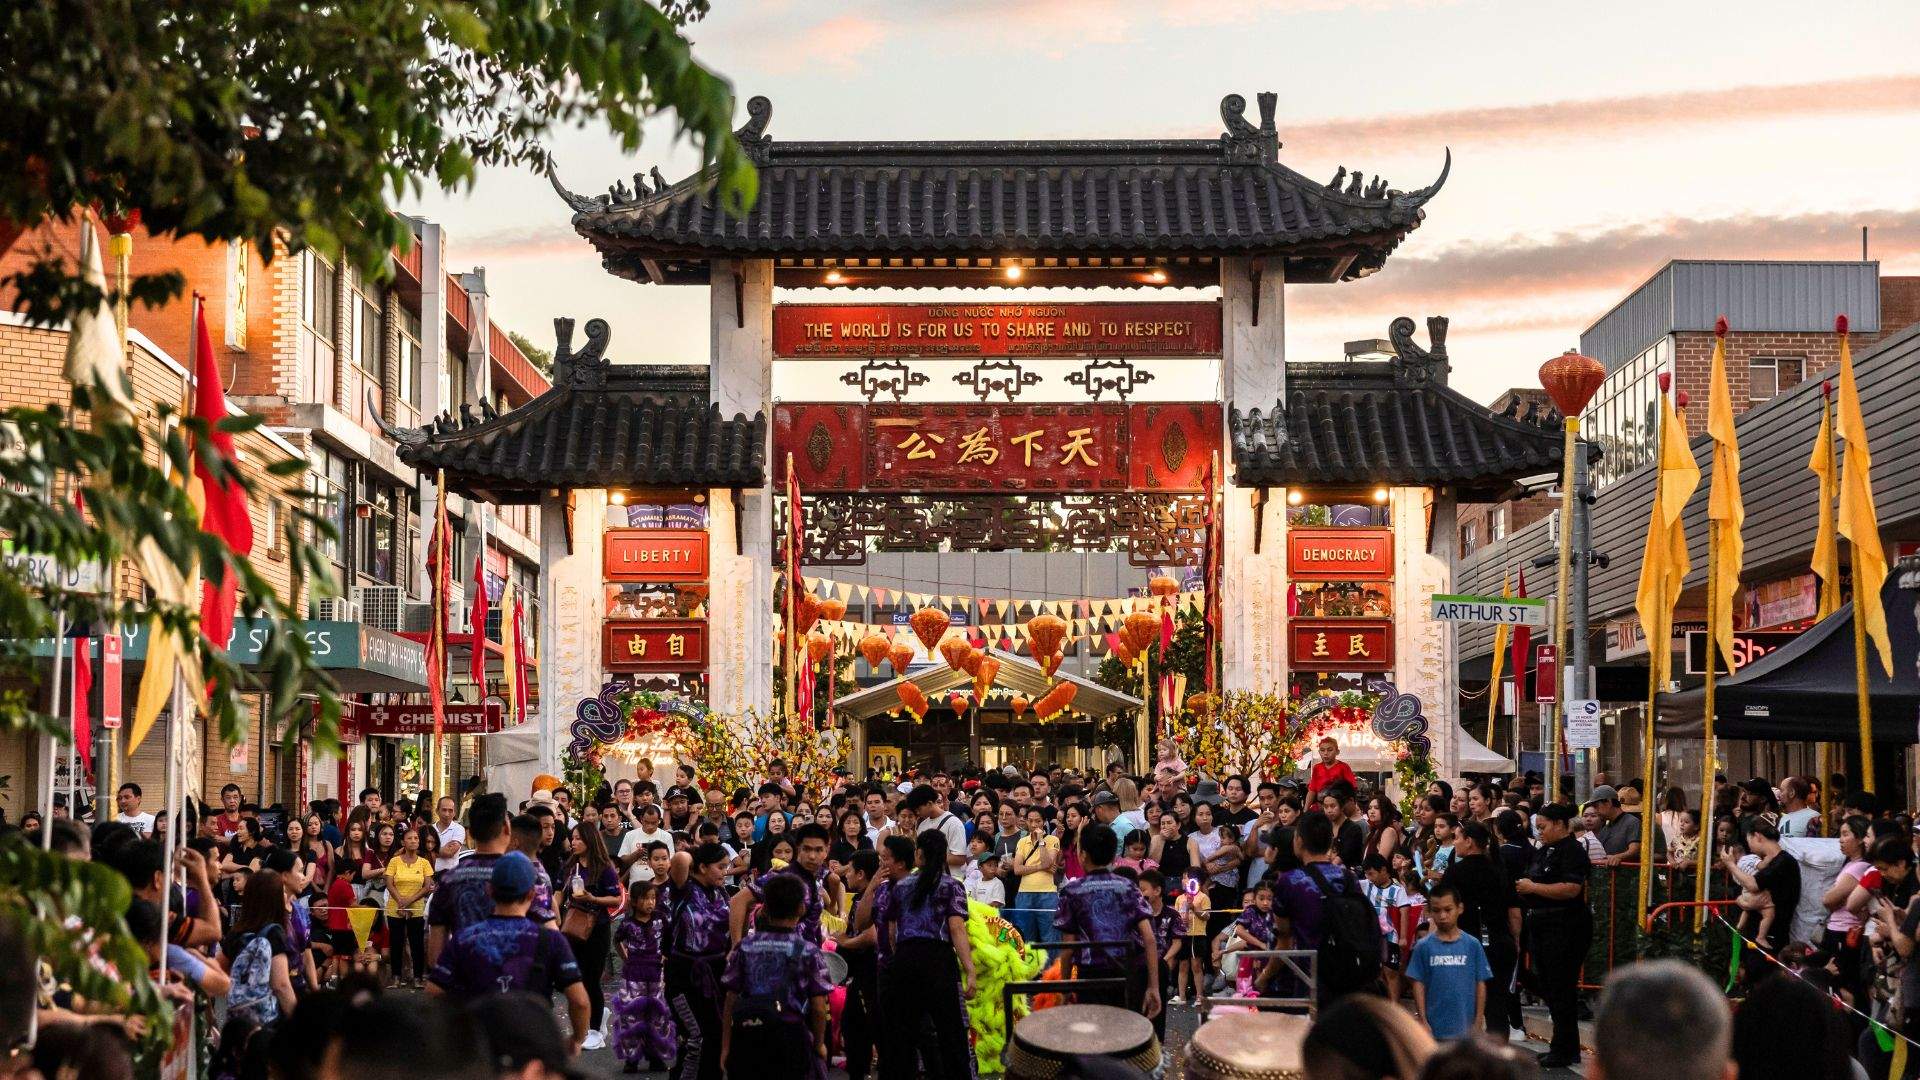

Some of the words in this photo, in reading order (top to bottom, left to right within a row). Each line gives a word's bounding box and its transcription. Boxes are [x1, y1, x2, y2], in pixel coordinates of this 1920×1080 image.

[804, 322, 833, 338] THE
[840, 322, 891, 338] WORLD
[897, 322, 912, 338] IS
[918, 322, 947, 338] FOR
[953, 322, 974, 338] US
[980, 322, 1000, 337] TO
[1006, 321, 1055, 337] SHARE
[1062, 321, 1092, 337] AND
[1099, 321, 1118, 337] TO
[1124, 321, 1193, 337] RESPECT
[622, 549, 692, 562] LIBERTY
[1302, 548, 1377, 561] DEMOCRACY
[893, 614, 906, 622] For
[1436, 603, 1504, 621] ARTHUR
[1508, 606, 1528, 622] ST
[248, 628, 331, 655] SES
[369, 636, 387, 663] EVERY
[387, 642, 399, 668] DAY
[400, 645, 417, 673] HAPPY
[1733, 638, 1776, 667] Sh
[398, 713, 484, 724] CHEMIST
[1429, 954, 1467, 966] LONSDALE
